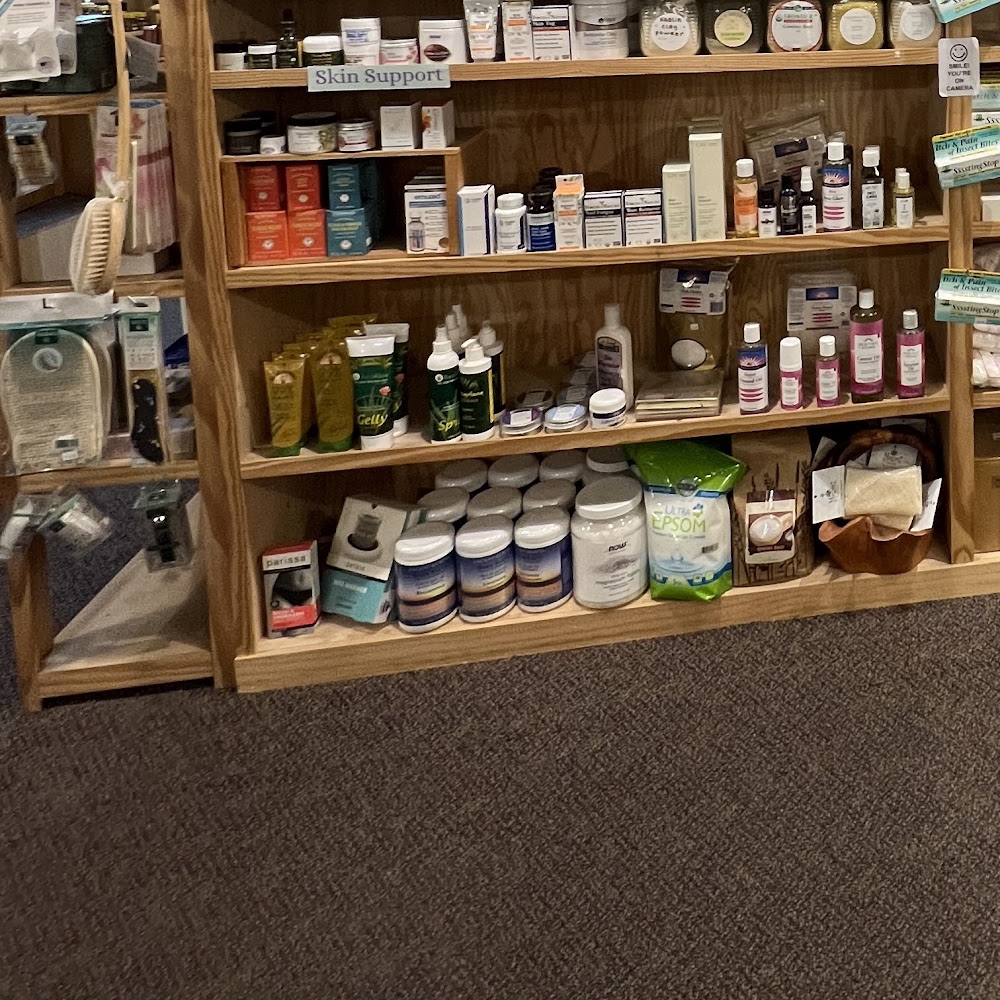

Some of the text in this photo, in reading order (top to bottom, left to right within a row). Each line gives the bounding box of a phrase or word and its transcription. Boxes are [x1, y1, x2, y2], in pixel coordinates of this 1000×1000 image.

[316, 68, 443, 86] Skin Support
[935, 140, 951, 151] Itch
[960, 137, 979, 146] Pain
[956, 144, 979, 154] Insect
[980, 140, 998, 149] Bites
[357, 414, 388, 427] Gelly
[652, 516, 706, 533] EPSOM
[266, 555, 306, 567] parissa
